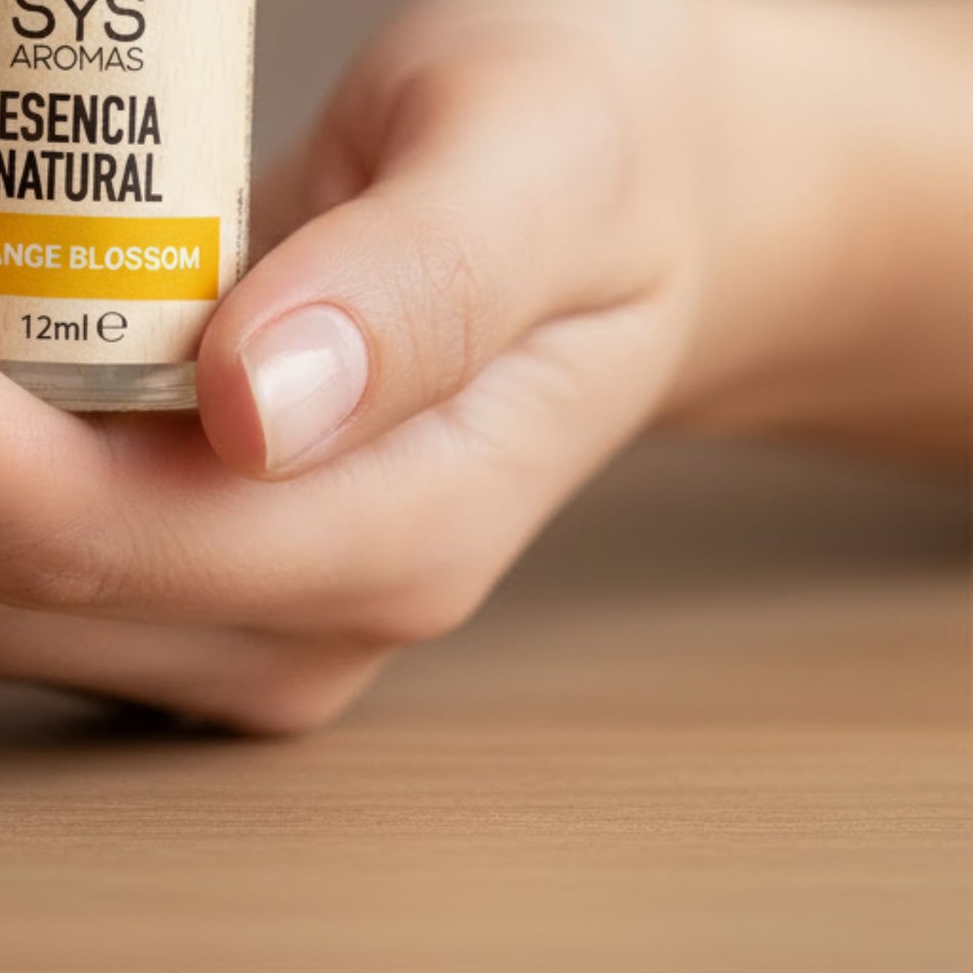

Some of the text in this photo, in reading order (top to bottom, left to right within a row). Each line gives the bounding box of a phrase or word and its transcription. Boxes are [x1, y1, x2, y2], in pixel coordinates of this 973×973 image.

[9, 44, 144, 72] AROMAS
[69, 245, 201, 271] BLOSSOM
[20, 313, 89, 341] 12ml
